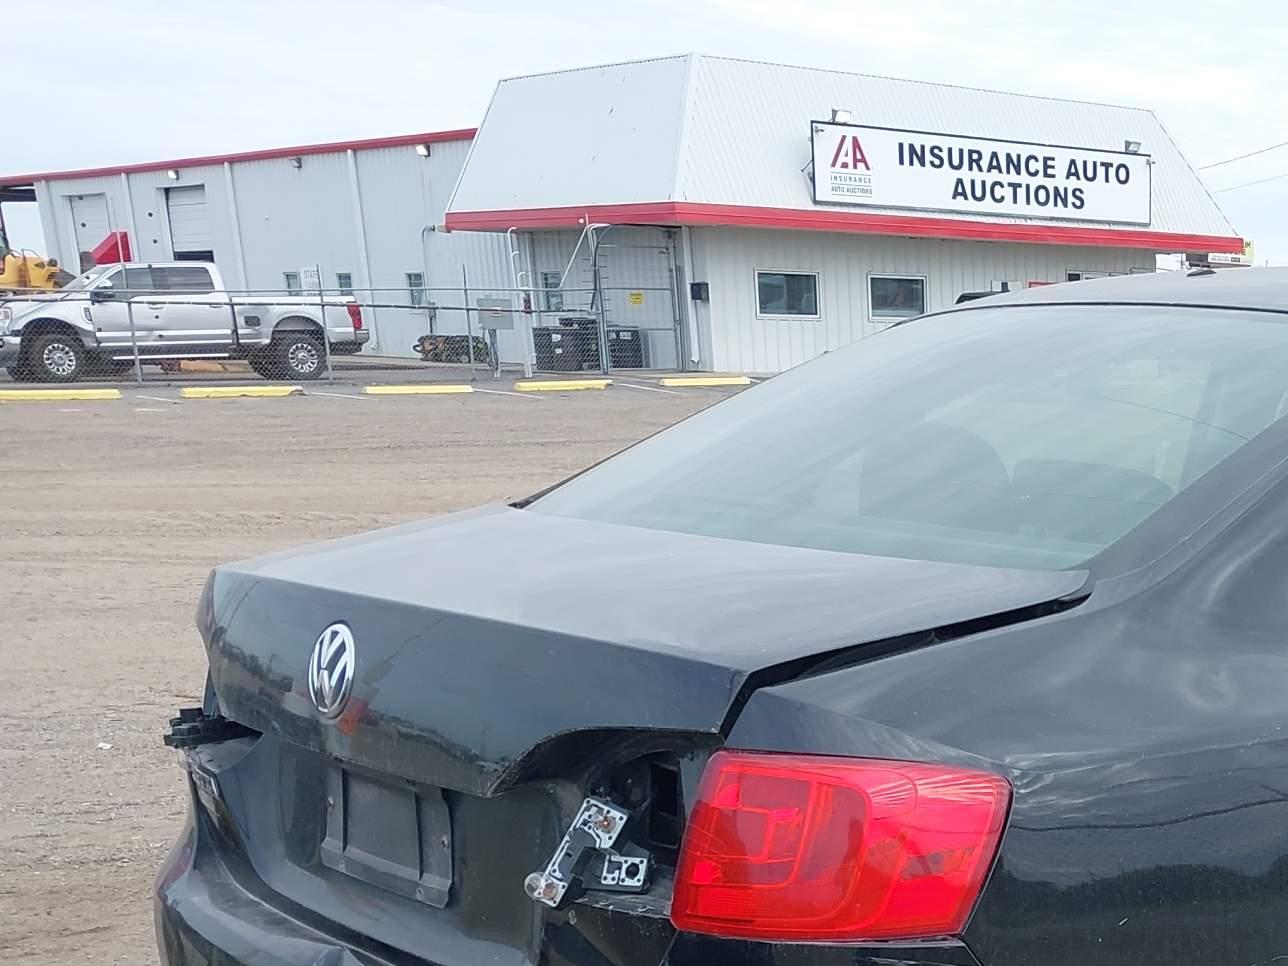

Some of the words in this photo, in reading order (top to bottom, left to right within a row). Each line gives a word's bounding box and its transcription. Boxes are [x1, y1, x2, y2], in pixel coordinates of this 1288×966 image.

[898, 142, 1057, 179] INSURANCE
[1064, 158, 1131, 186] AUTO
[830, 175, 872, 184] INSURANCE
[831, 185, 845, 193] AUTO
[846, 186, 873, 195] AUCTIONS
[951, 177, 1087, 210] AUCTIONS
